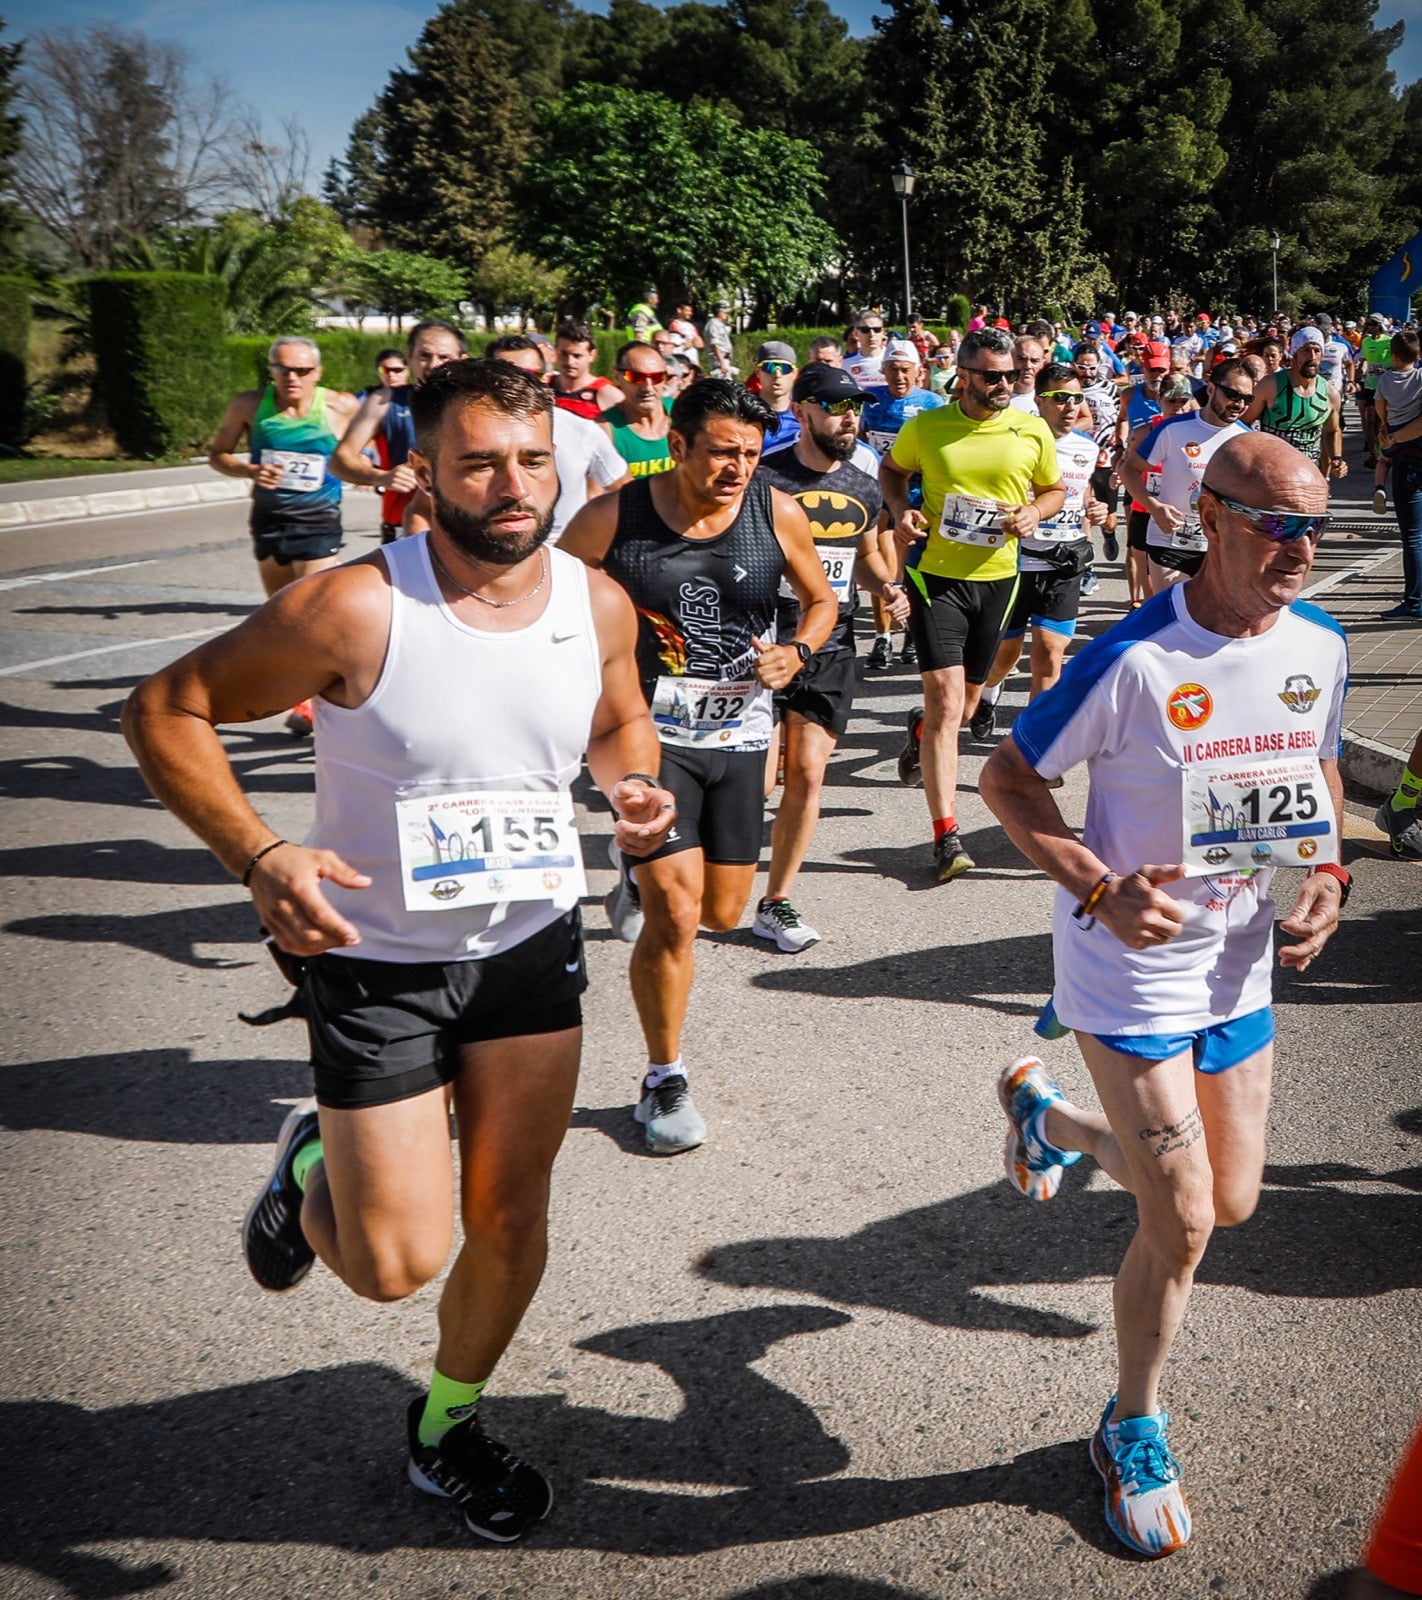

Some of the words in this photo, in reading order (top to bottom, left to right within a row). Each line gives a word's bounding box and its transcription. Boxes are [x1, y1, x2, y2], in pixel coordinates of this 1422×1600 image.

[289, 460, 310, 474] 27
[974, 508, 998, 527] 77
[1057, 510, 1081, 524] 226
[695, 696, 744, 721] 132
[1183, 745, 1192, 763] II
[1196, 736, 1252, 761] CARRERA
[1254, 732, 1285, 753] BASE
[1220, 770, 1265, 782] CARRERA
[1266, 766, 1288, 775] BASE
[1241, 782, 1318, 824] 125
[471, 816, 560, 853] 155
[1236, 827, 1256, 841] JUAN
[1256, 825, 1288, 840] CARLOS
